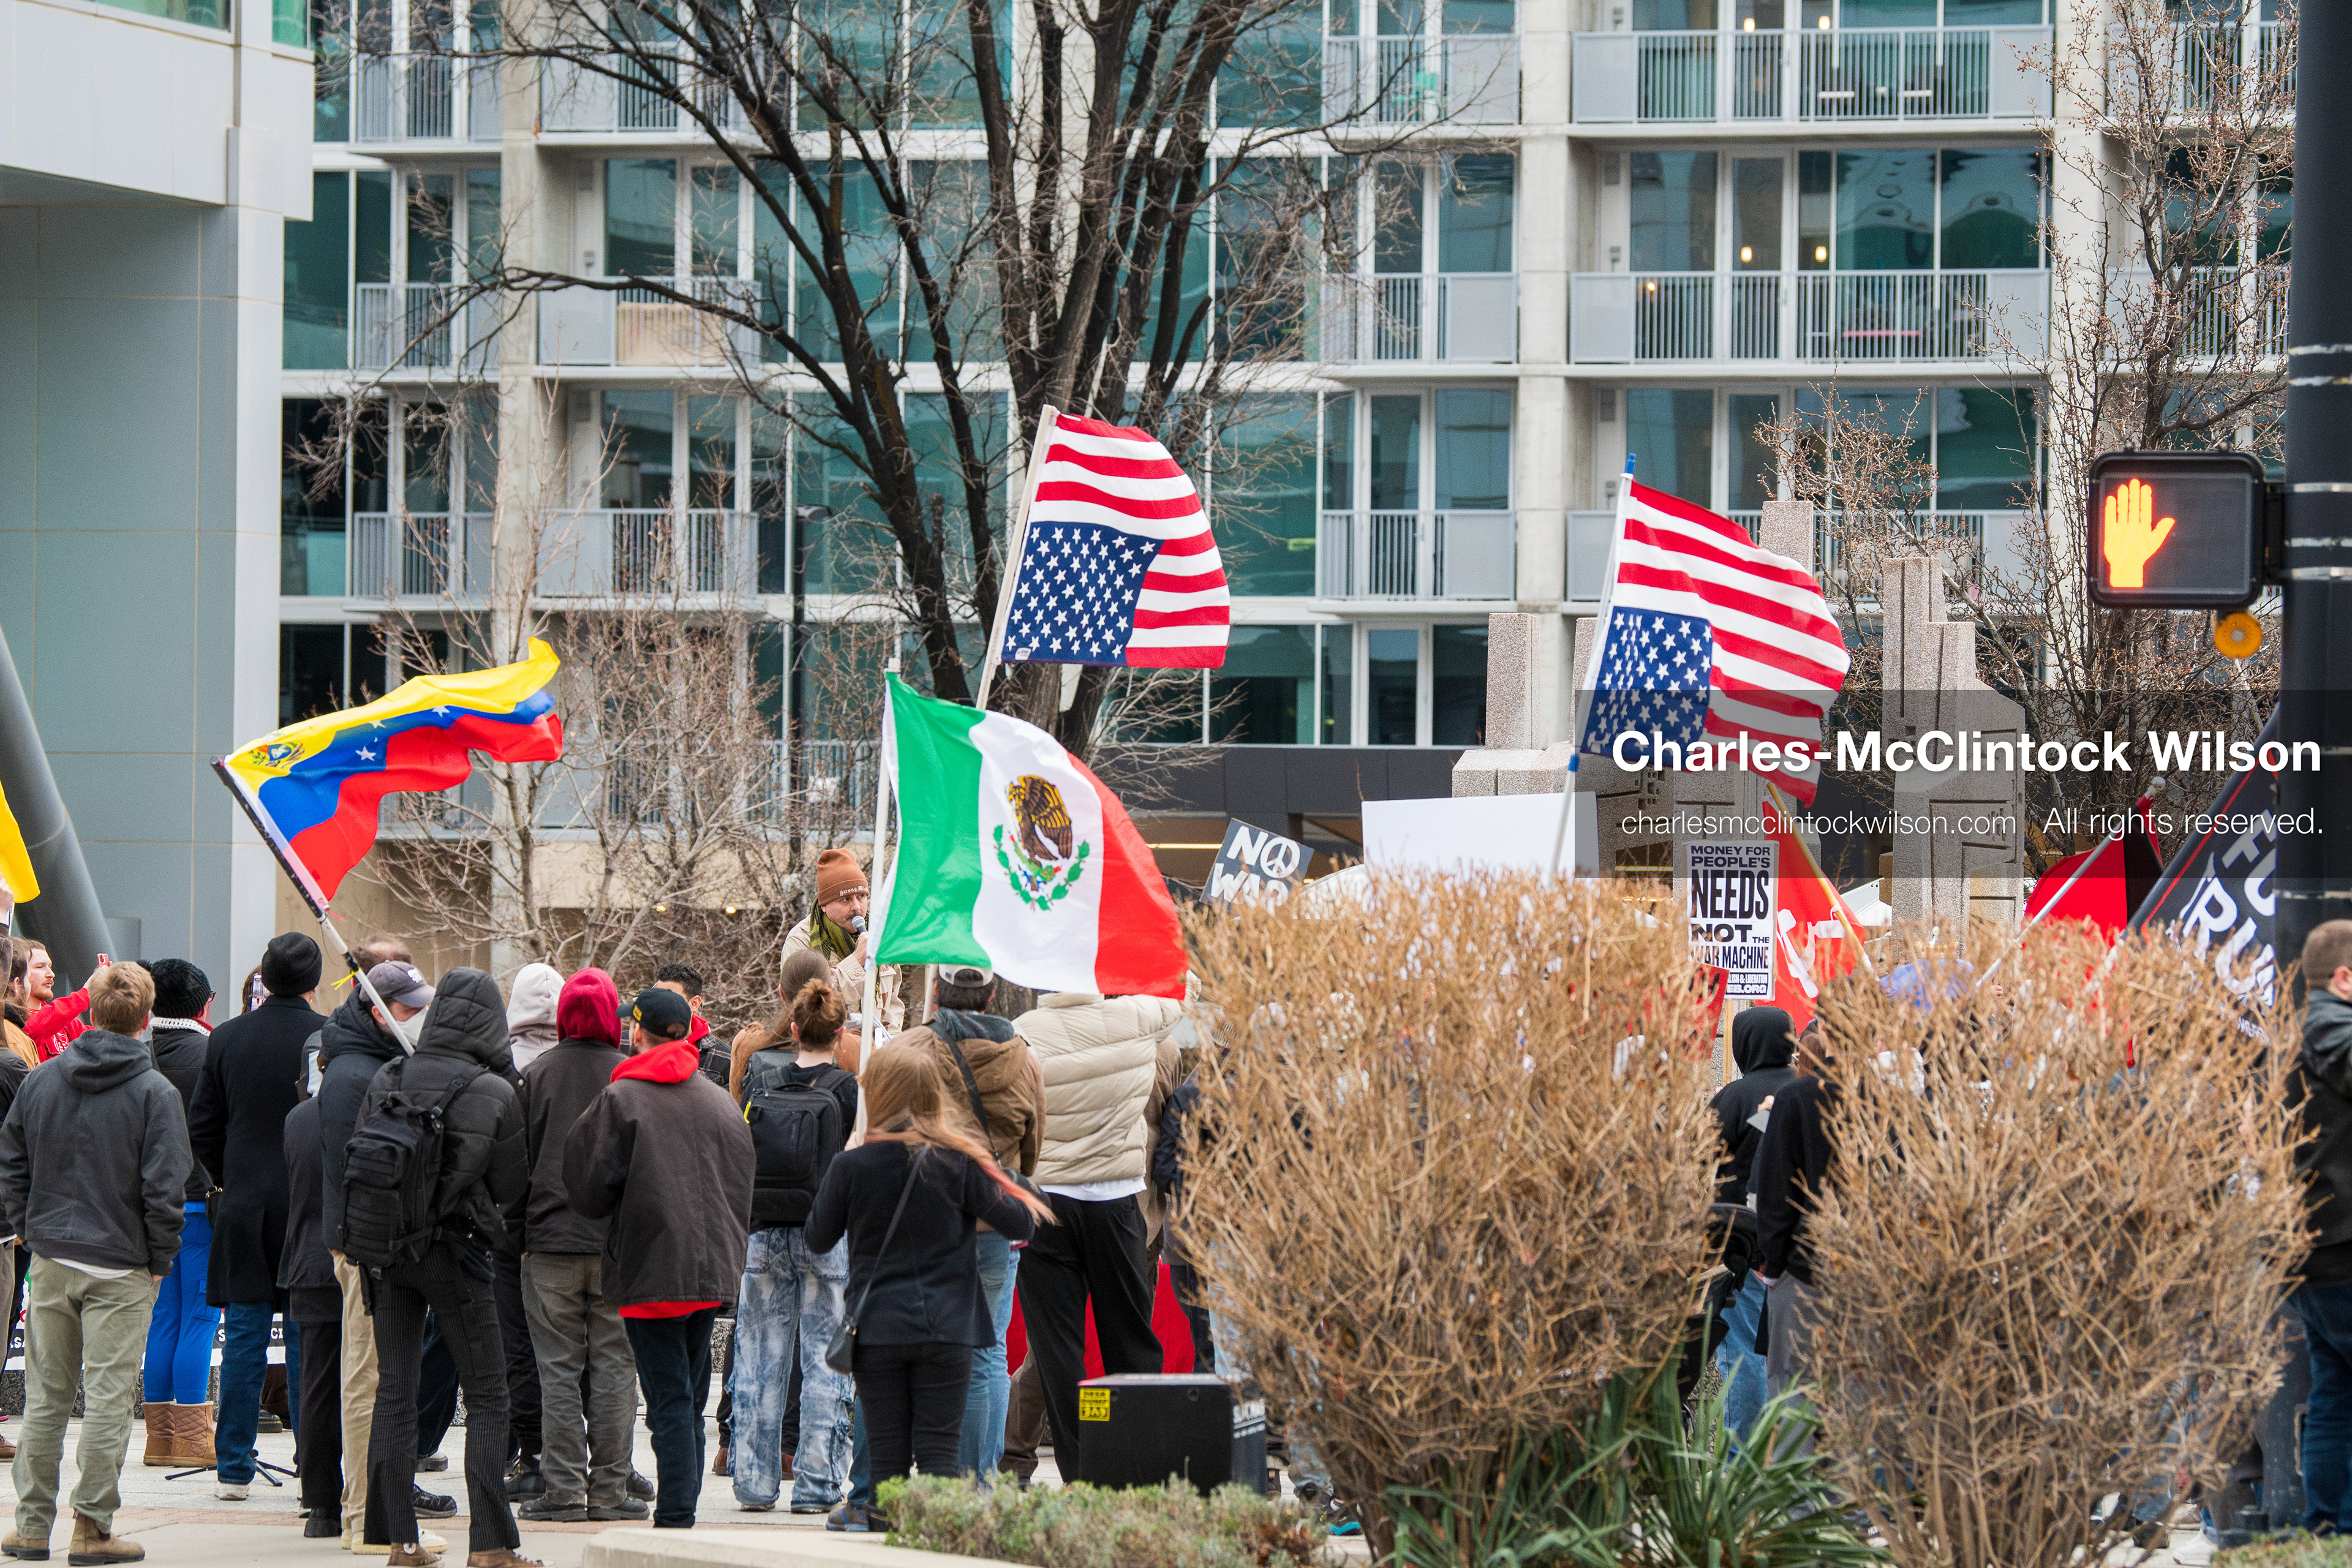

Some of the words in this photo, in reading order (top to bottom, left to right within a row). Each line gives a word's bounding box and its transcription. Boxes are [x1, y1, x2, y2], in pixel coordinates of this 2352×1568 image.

[1227, 825, 1300, 878] NO
[1691, 846, 1743, 855] MONEY
[1746, 846, 1770, 856] FOR
[1691, 856, 1770, 868] PEOPLE'S
[2222, 809, 2277, 916] FU
[839, 887, 857, 896] Strong
[1691, 869, 1770, 920] NEEDS
[1691, 924, 1752, 943] NOT
[1722, 946, 1769, 969] MACHINE
[1740, 974, 1745, 984] &
[1727, 984, 1767, 993] EB.ORG
